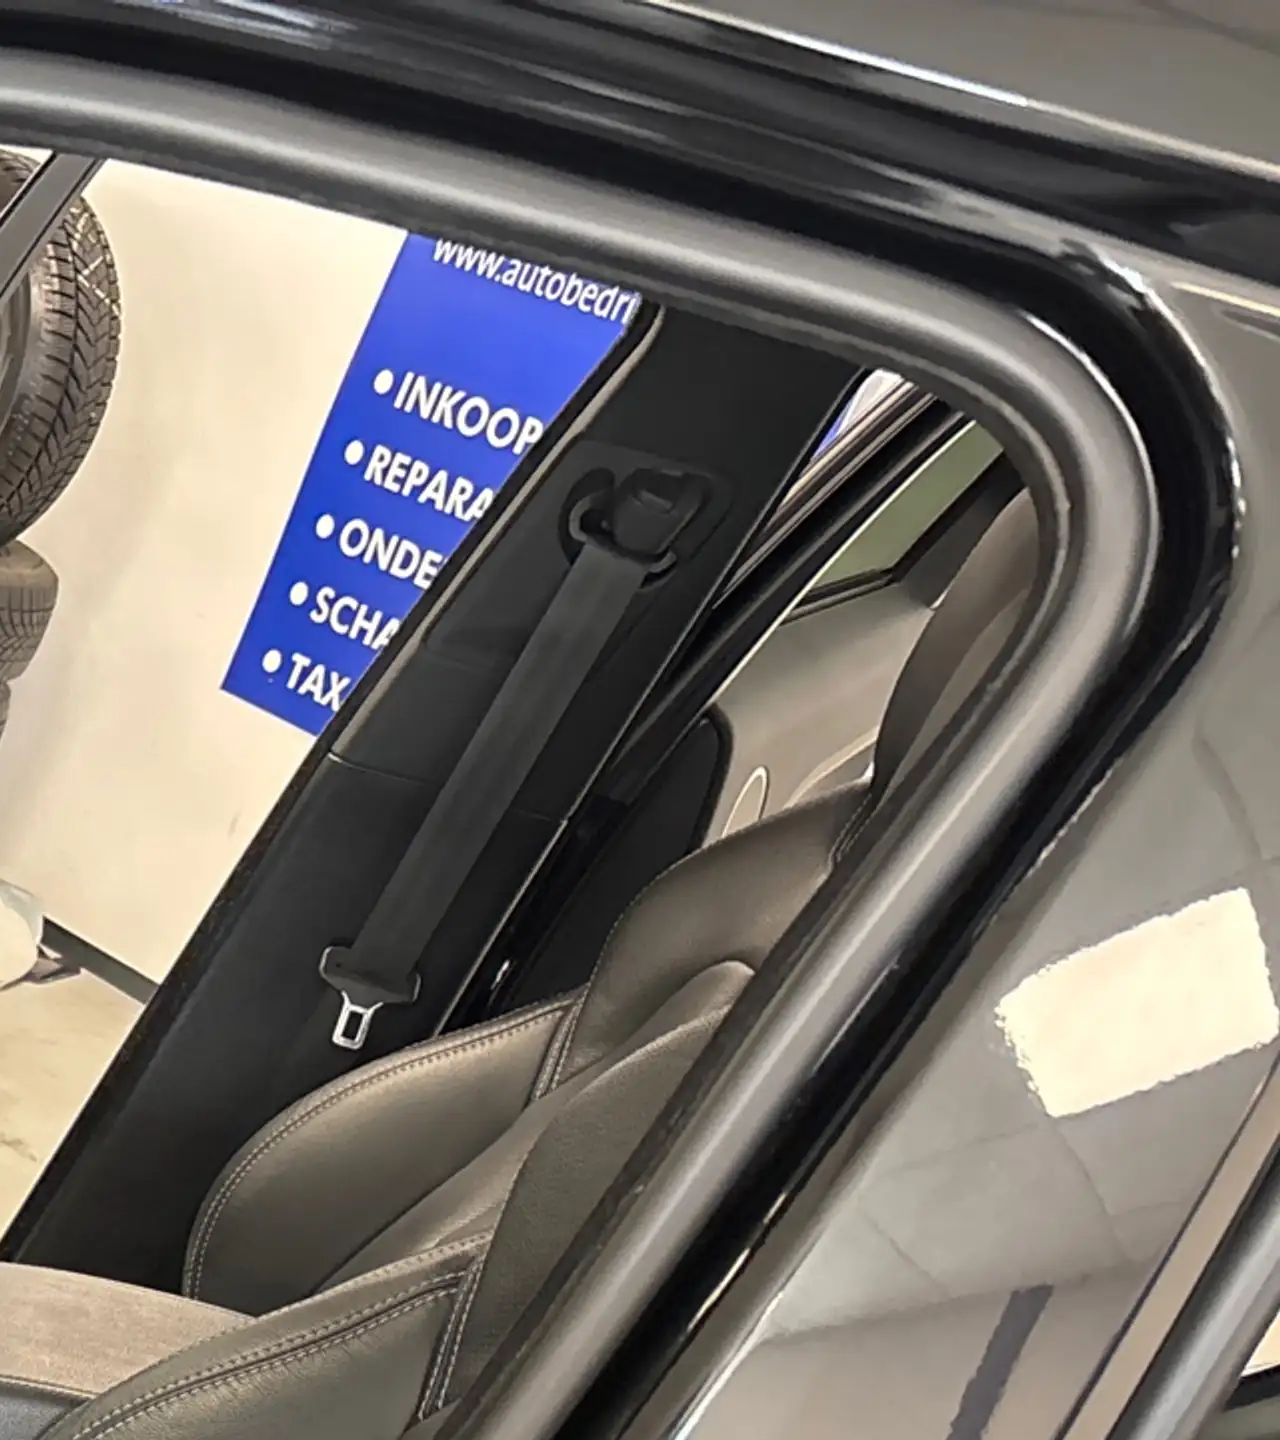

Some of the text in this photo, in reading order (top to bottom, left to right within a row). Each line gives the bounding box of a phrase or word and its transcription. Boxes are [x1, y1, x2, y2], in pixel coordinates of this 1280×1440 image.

[393, 372, 544, 456] INKOOP
[363, 445, 494, 522] REPARA
[339, 520, 445, 590] ONDE
[309, 586, 400, 650] SCHA
